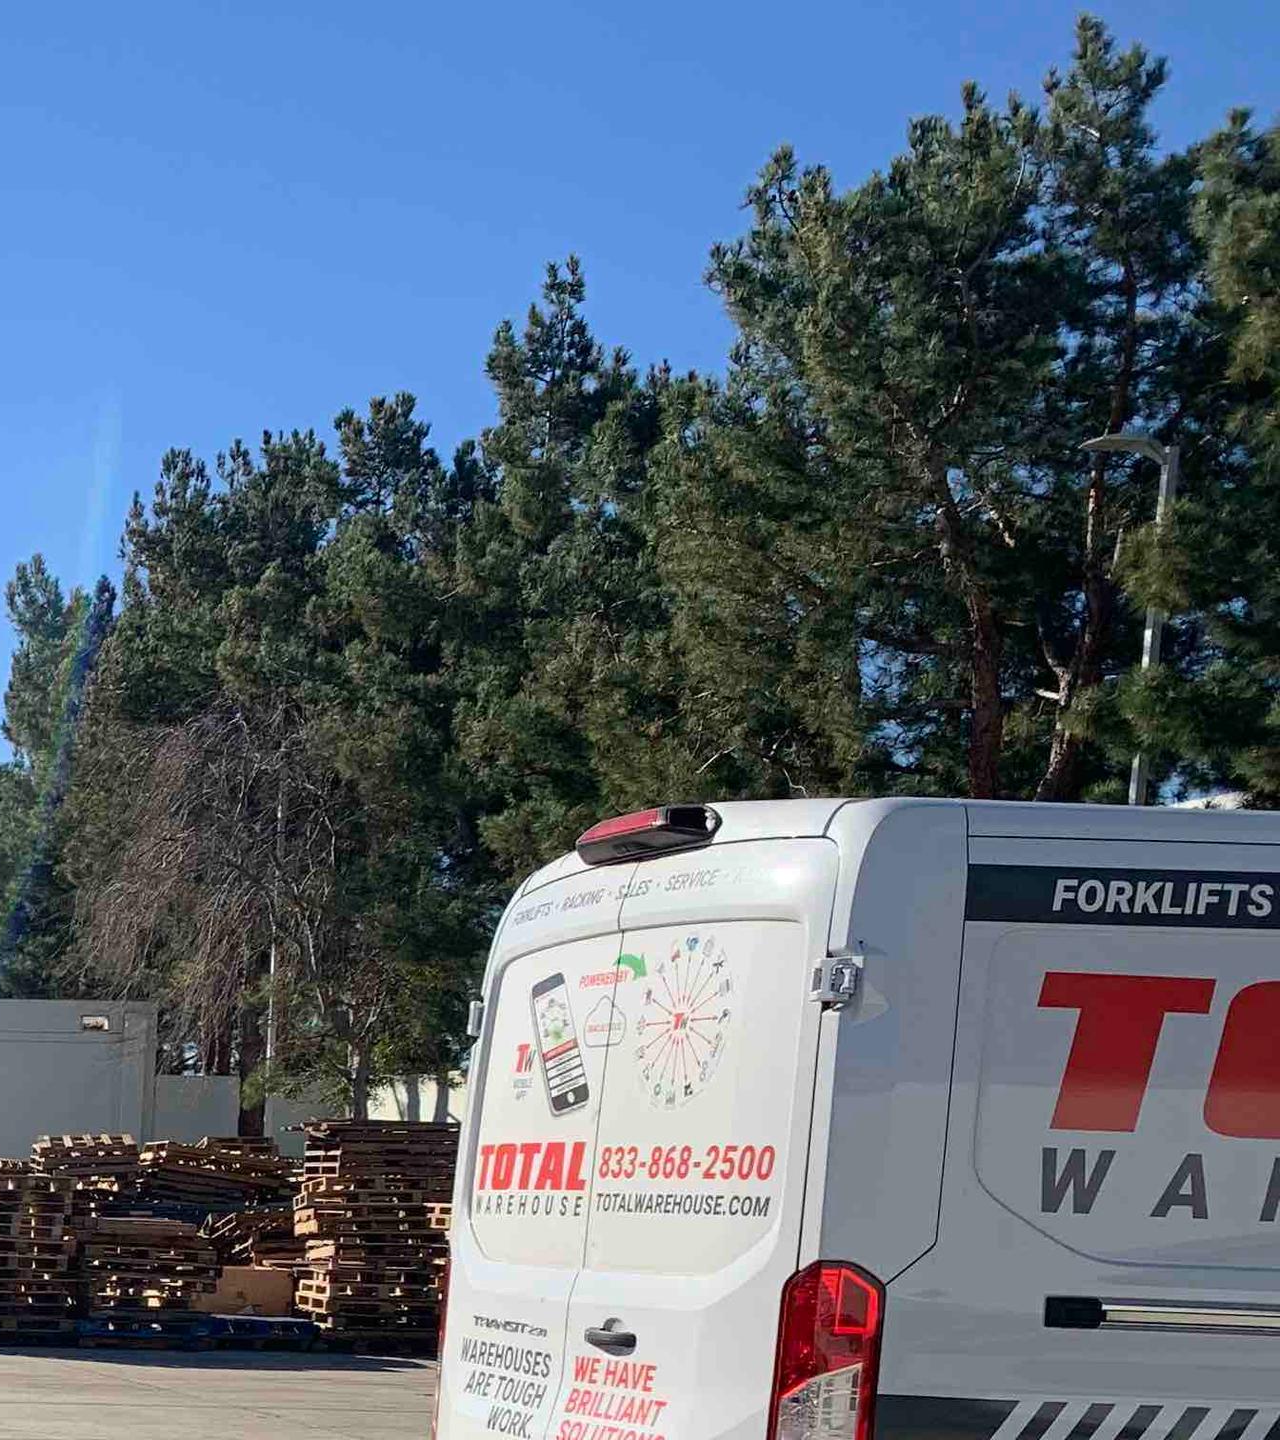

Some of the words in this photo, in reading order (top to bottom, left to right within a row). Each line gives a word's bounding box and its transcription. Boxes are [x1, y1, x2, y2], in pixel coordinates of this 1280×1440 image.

[561, 887, 605, 912] RACKING
[615, 878, 652, 900] SALES
[663, 868, 720, 892] SERVICE
[1052, 878, 1274, 917] FORKLIFTS
[478, 1141, 587, 1191] TOTAL
[598, 1145, 776, 1181] 833-868-2500
[476, 1194, 583, 1217] WAREHOUSE
[596, 1192, 771, 1218] TOTALWAREHOUSE.COM
[473, 1314, 527, 1335] TRANSIT
[460, 1336, 553, 1379] WAREHOUSES
[573, 1355, 601, 1385] WE
[604, 1360, 658, 1393] HAVE
[464, 1370, 493, 1397] ARE
[494, 1376, 547, 1410] TOUGH
[564, 1388, 669, 1428] BRILLIANT
[487, 1404, 534, 1440] WORK.
